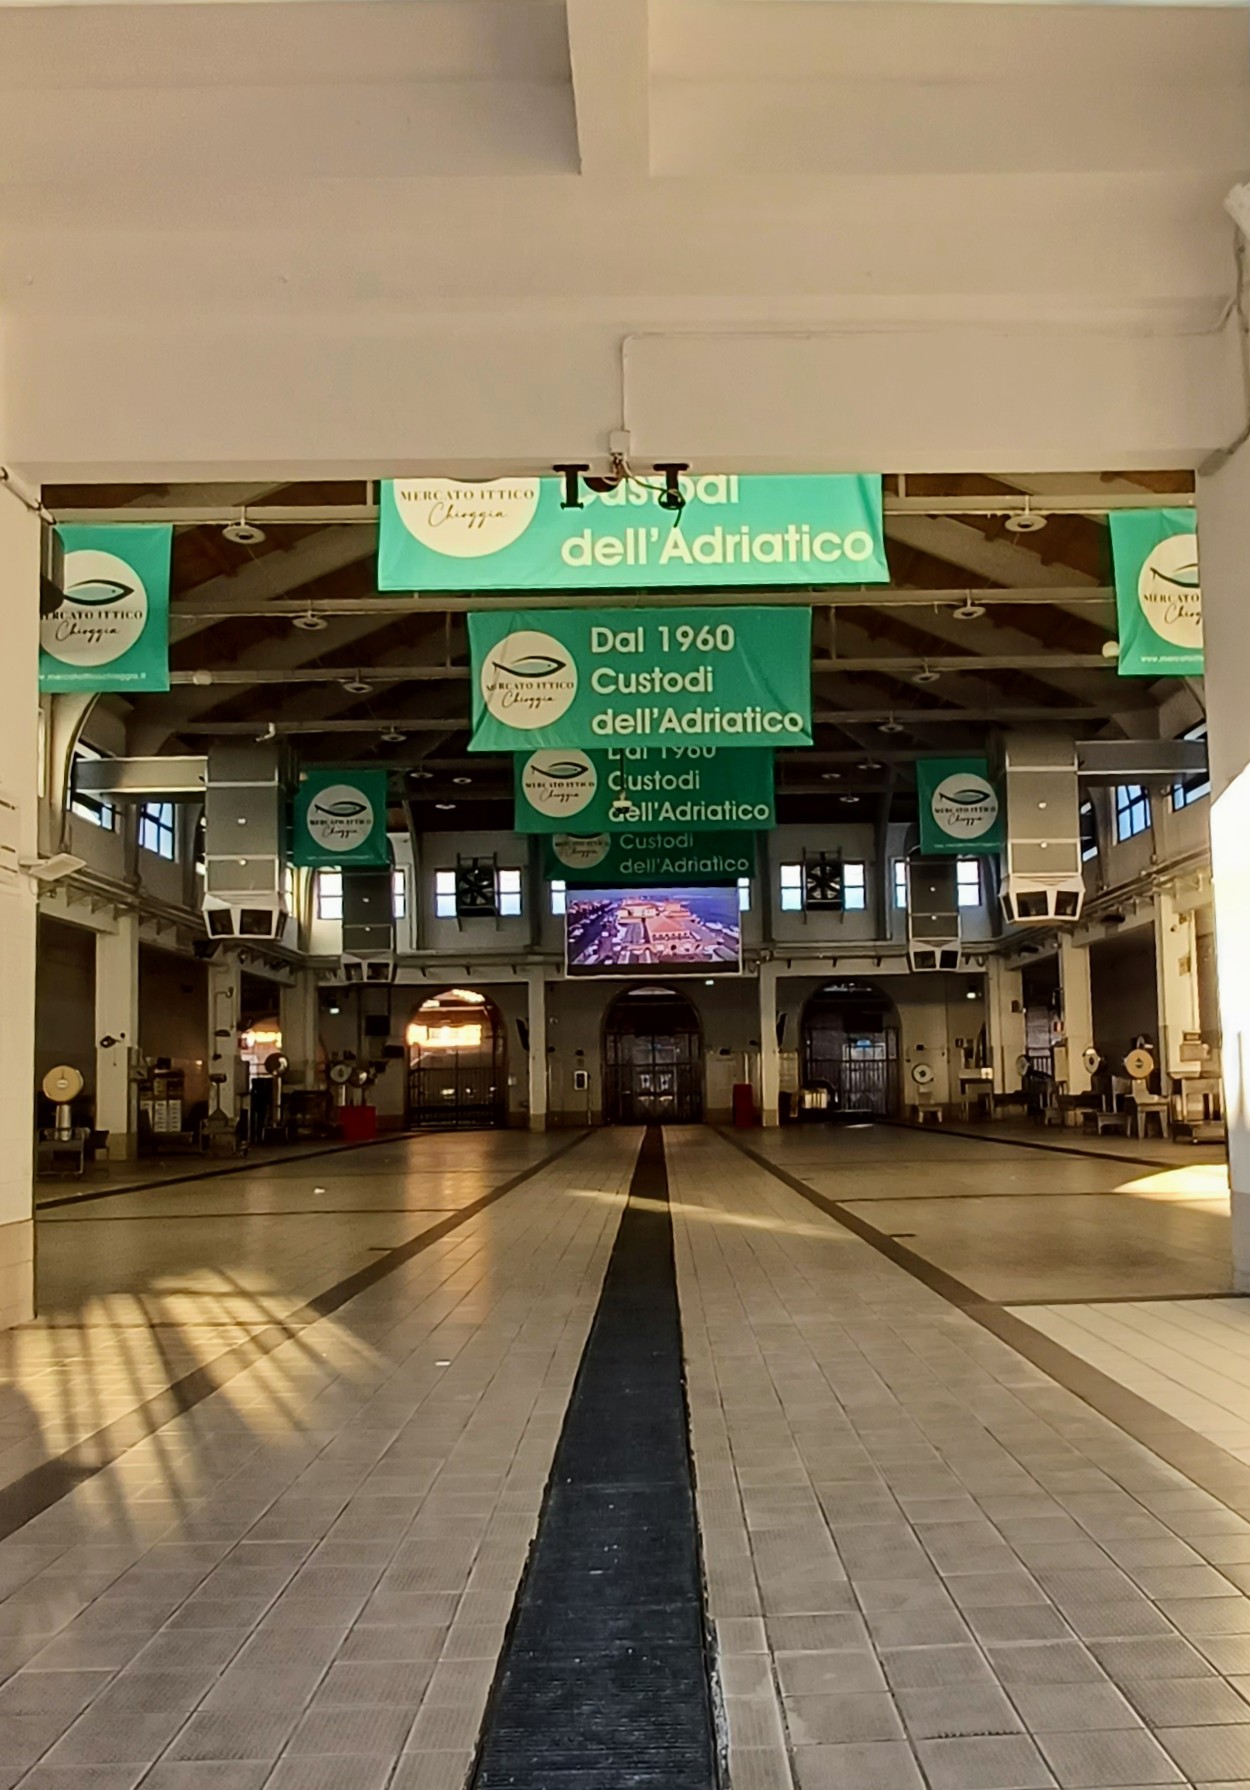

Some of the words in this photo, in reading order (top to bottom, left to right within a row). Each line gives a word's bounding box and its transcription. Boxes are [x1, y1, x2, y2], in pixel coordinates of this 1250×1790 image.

[400, 489, 475, 502] MERCATO
[480, 489, 535, 500] ITTICO
[428, 501, 507, 529] Chioggia
[561, 524, 875, 566] dell'Adriatico
[98, 610, 143, 619] ITTICO
[55, 619, 119, 643] Chioggia
[591, 626, 644, 653] Dal
[658, 624, 735, 652] 1960
[591, 666, 713, 694] Custodi
[591, 706, 804, 735] dell'Adriatico
[608, 769, 700, 791] Custodi
[619, 832, 694, 849] Custodi
[619, 855, 750, 874] dell'Adriatico
